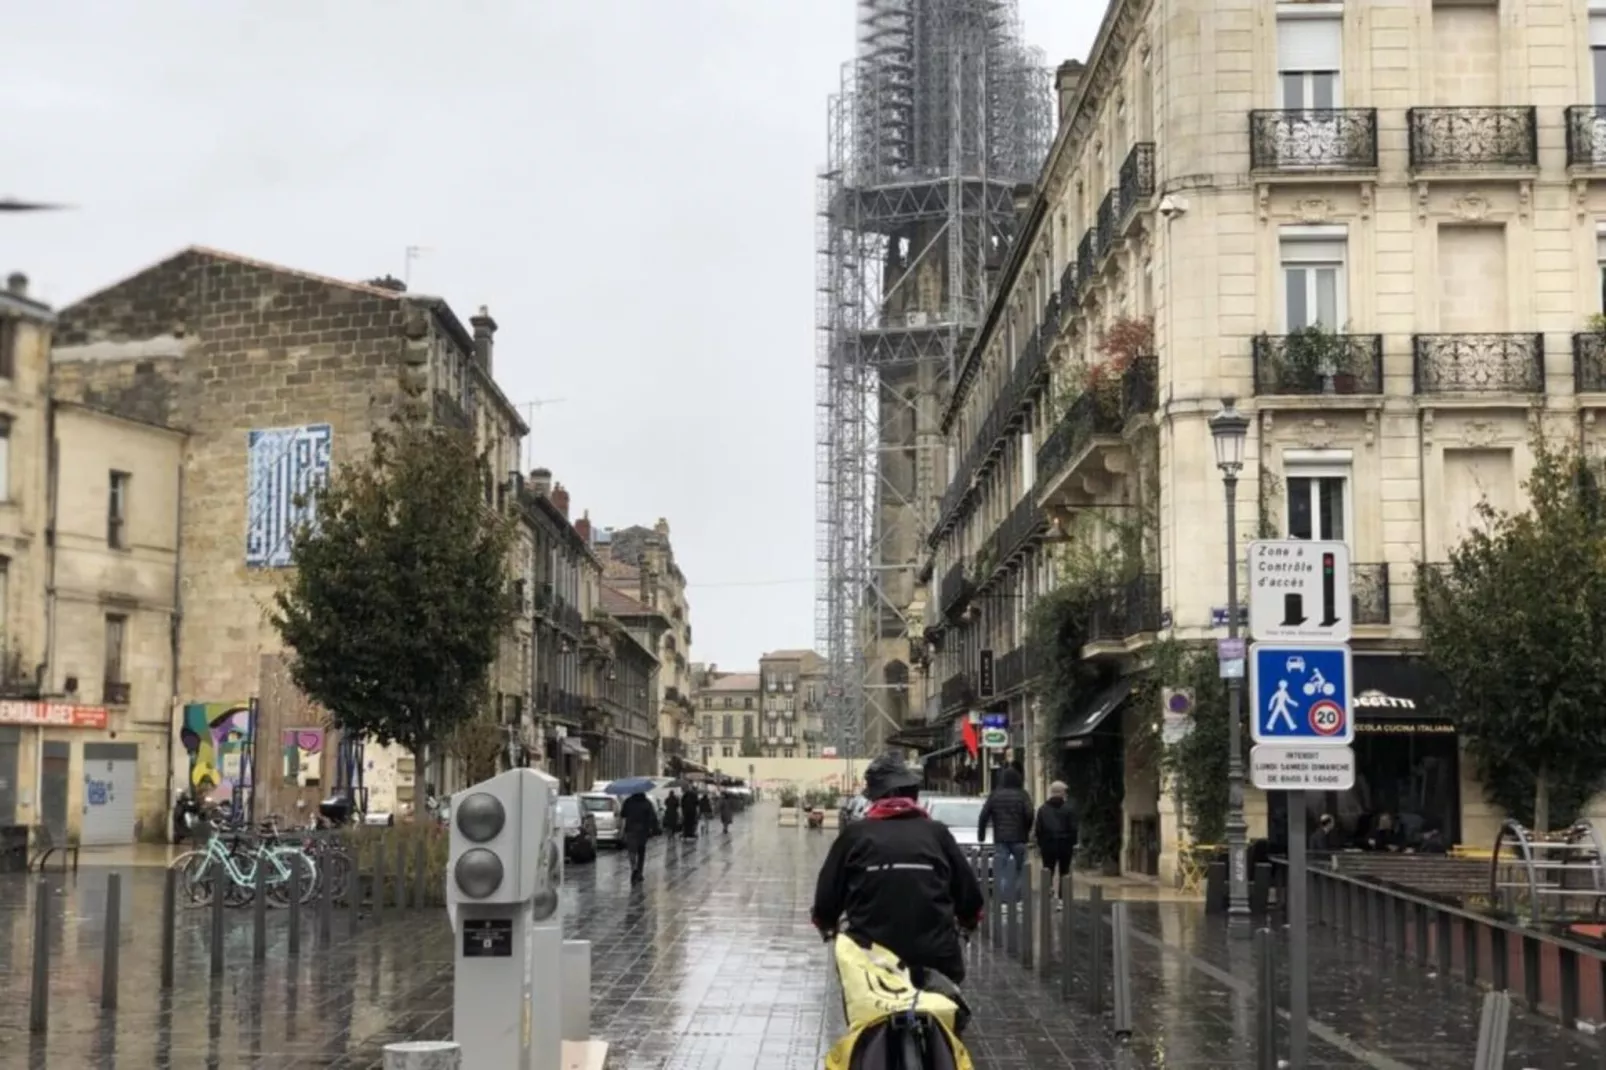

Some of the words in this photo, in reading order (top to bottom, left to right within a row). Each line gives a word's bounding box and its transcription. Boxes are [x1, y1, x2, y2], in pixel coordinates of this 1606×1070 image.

[1258, 546, 1289, 556] Zone
[1258, 561, 1313, 572] Contrôle
[1258, 576, 1304, 587] d'accès
[1317, 711, 1336, 724] 20
[1417, 724, 1455, 733] ITALIANA
[1256, 763, 1277, 771] LUNDI
[1280, 763, 1309, 771] SAMEDI
[1311, 763, 1349, 771] DIMANCHE
